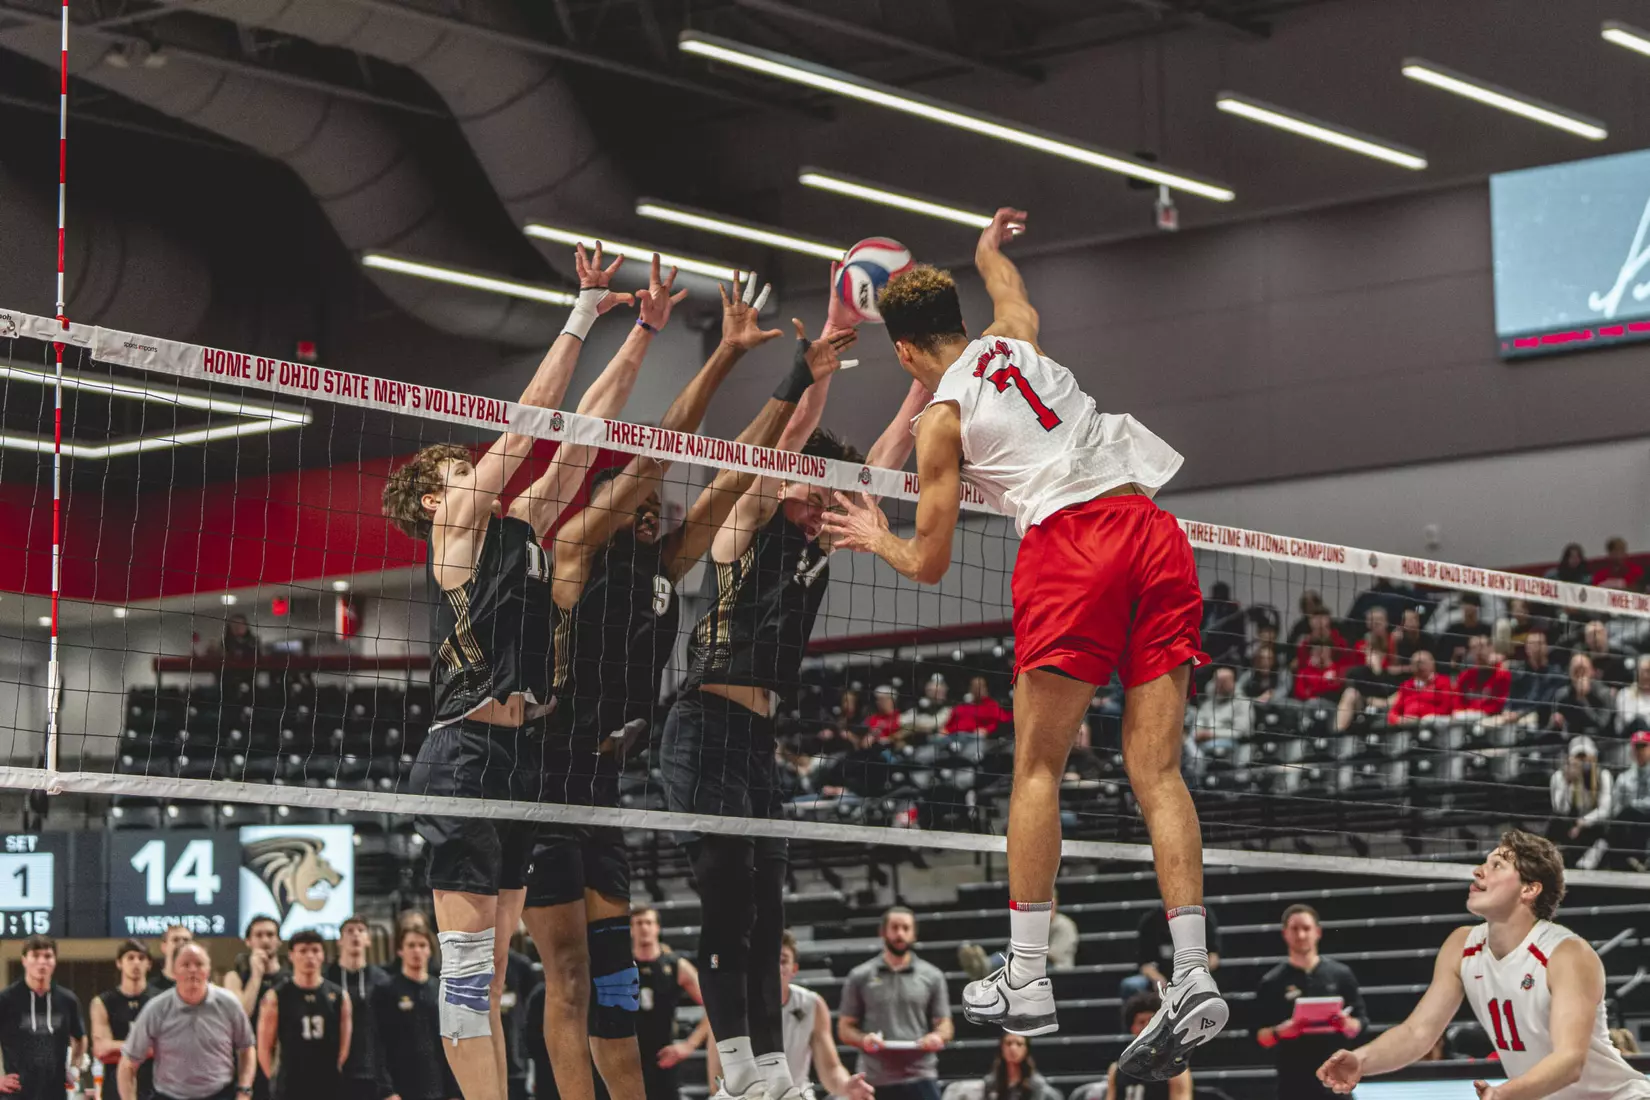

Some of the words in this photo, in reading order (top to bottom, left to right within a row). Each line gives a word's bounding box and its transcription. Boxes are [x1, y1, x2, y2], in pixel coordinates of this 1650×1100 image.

[123, 341, 137, 350] sports
[203, 347, 251, 379] HOME
[255, 357, 275, 383] OF
[279, 361, 320, 391] OHIO
[323, 371, 369, 400] STATE
[373, 378, 421, 409] MEN'S
[424, 388, 510, 425] VOLLEYBALL
[986, 363, 1063, 432] 7
[603, 419, 683, 454] THREE-TIME
[685, 435, 749, 467] NATIONAL
[751, 446, 827, 479] CHAMPIONS
[903, 472, 919, 495] HO
[1184, 521, 1241, 547] THREE-TIME
[1243, 532, 1289, 556] NATIONAL
[1290, 539, 1345, 564] CHAMPIONS
[1401, 557, 1426, 577] HOME
[1427, 562, 1438, 580] OF
[1439, 564, 1460, 583] OHIO
[1462, 568, 1486, 587] STATE
[1487, 572, 1512, 592] MEN'S
[1513, 576, 1559, 599] VOLLEYBALL
[5, 835, 38, 852] SET
[13, 864, 29, 897] 1
[130, 839, 222, 906] 14
[124, 915, 211, 934] TIMEOUTS:
[213, 915, 226, 934] 2
[301, 1015, 324, 1040] 13
[1488, 997, 1527, 1052] 11
